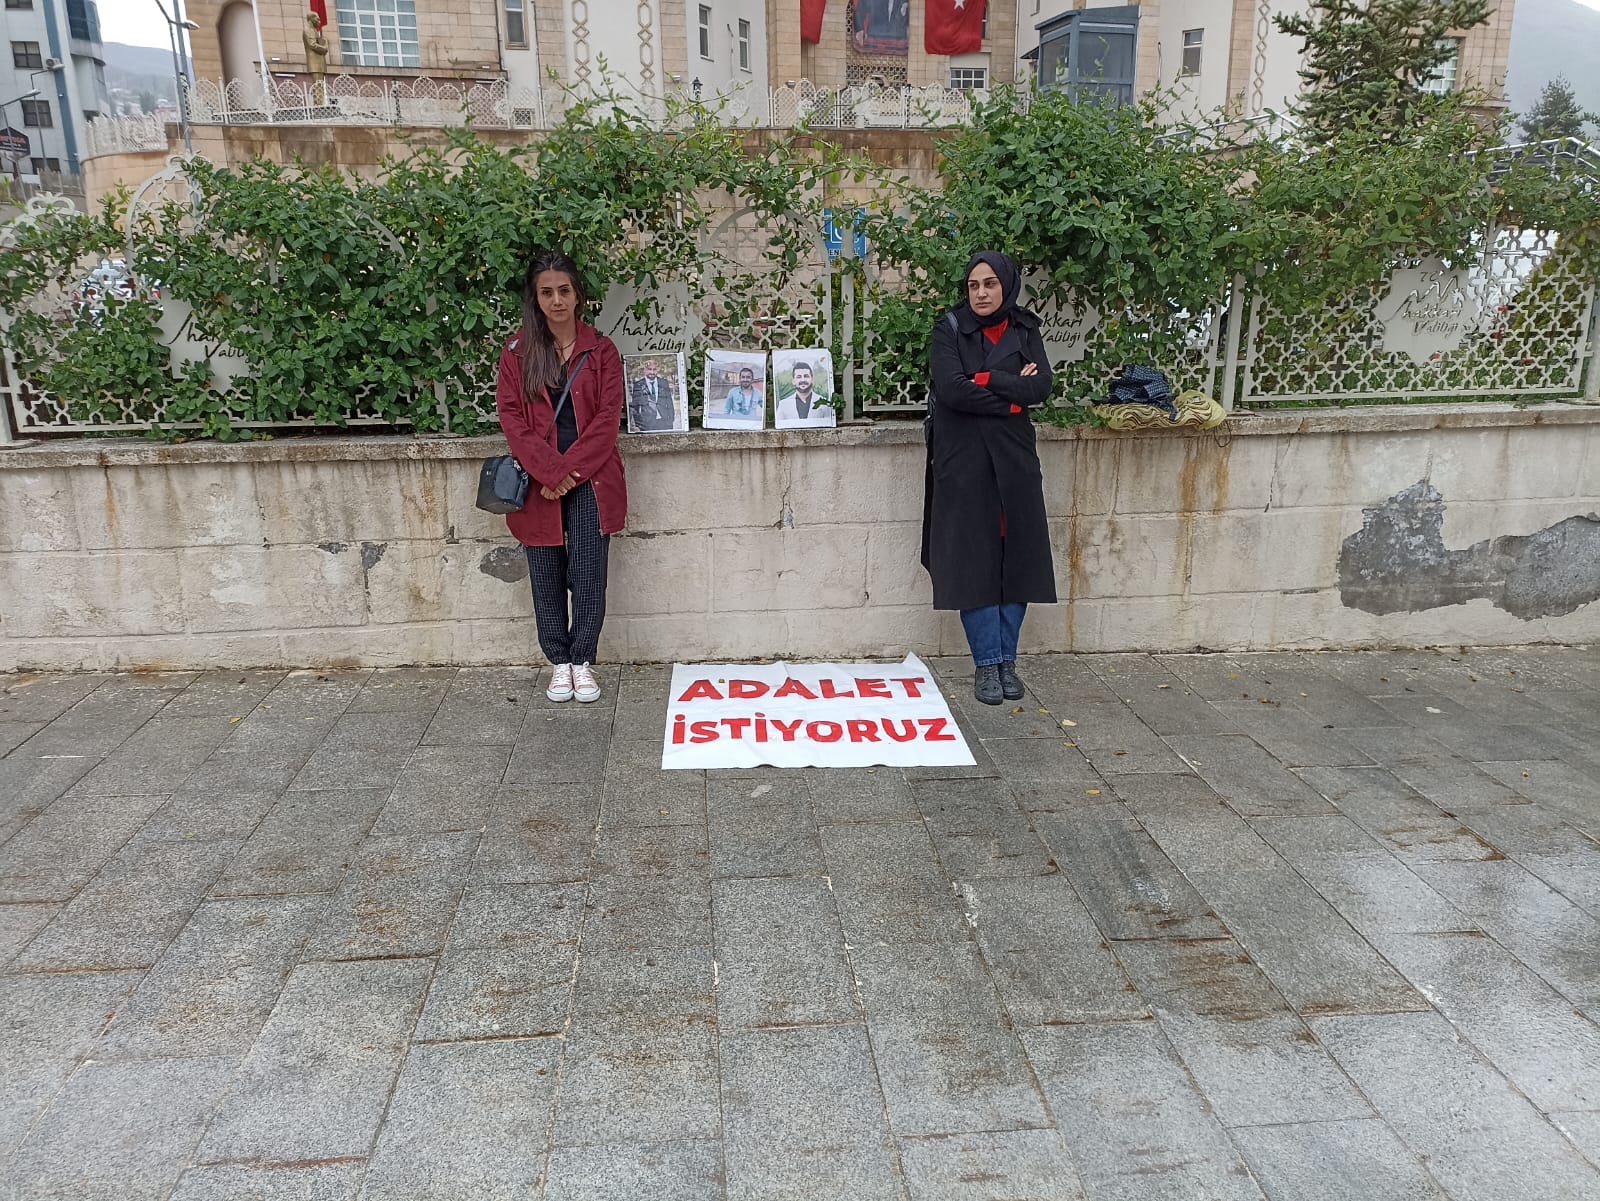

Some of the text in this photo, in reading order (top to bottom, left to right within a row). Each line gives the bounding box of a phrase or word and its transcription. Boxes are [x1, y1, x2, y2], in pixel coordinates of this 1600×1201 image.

[1042, 311, 1083, 328] kkari
[677, 676, 926, 702] ADALET
[672, 711, 956, 744] İSTİYORUZ
